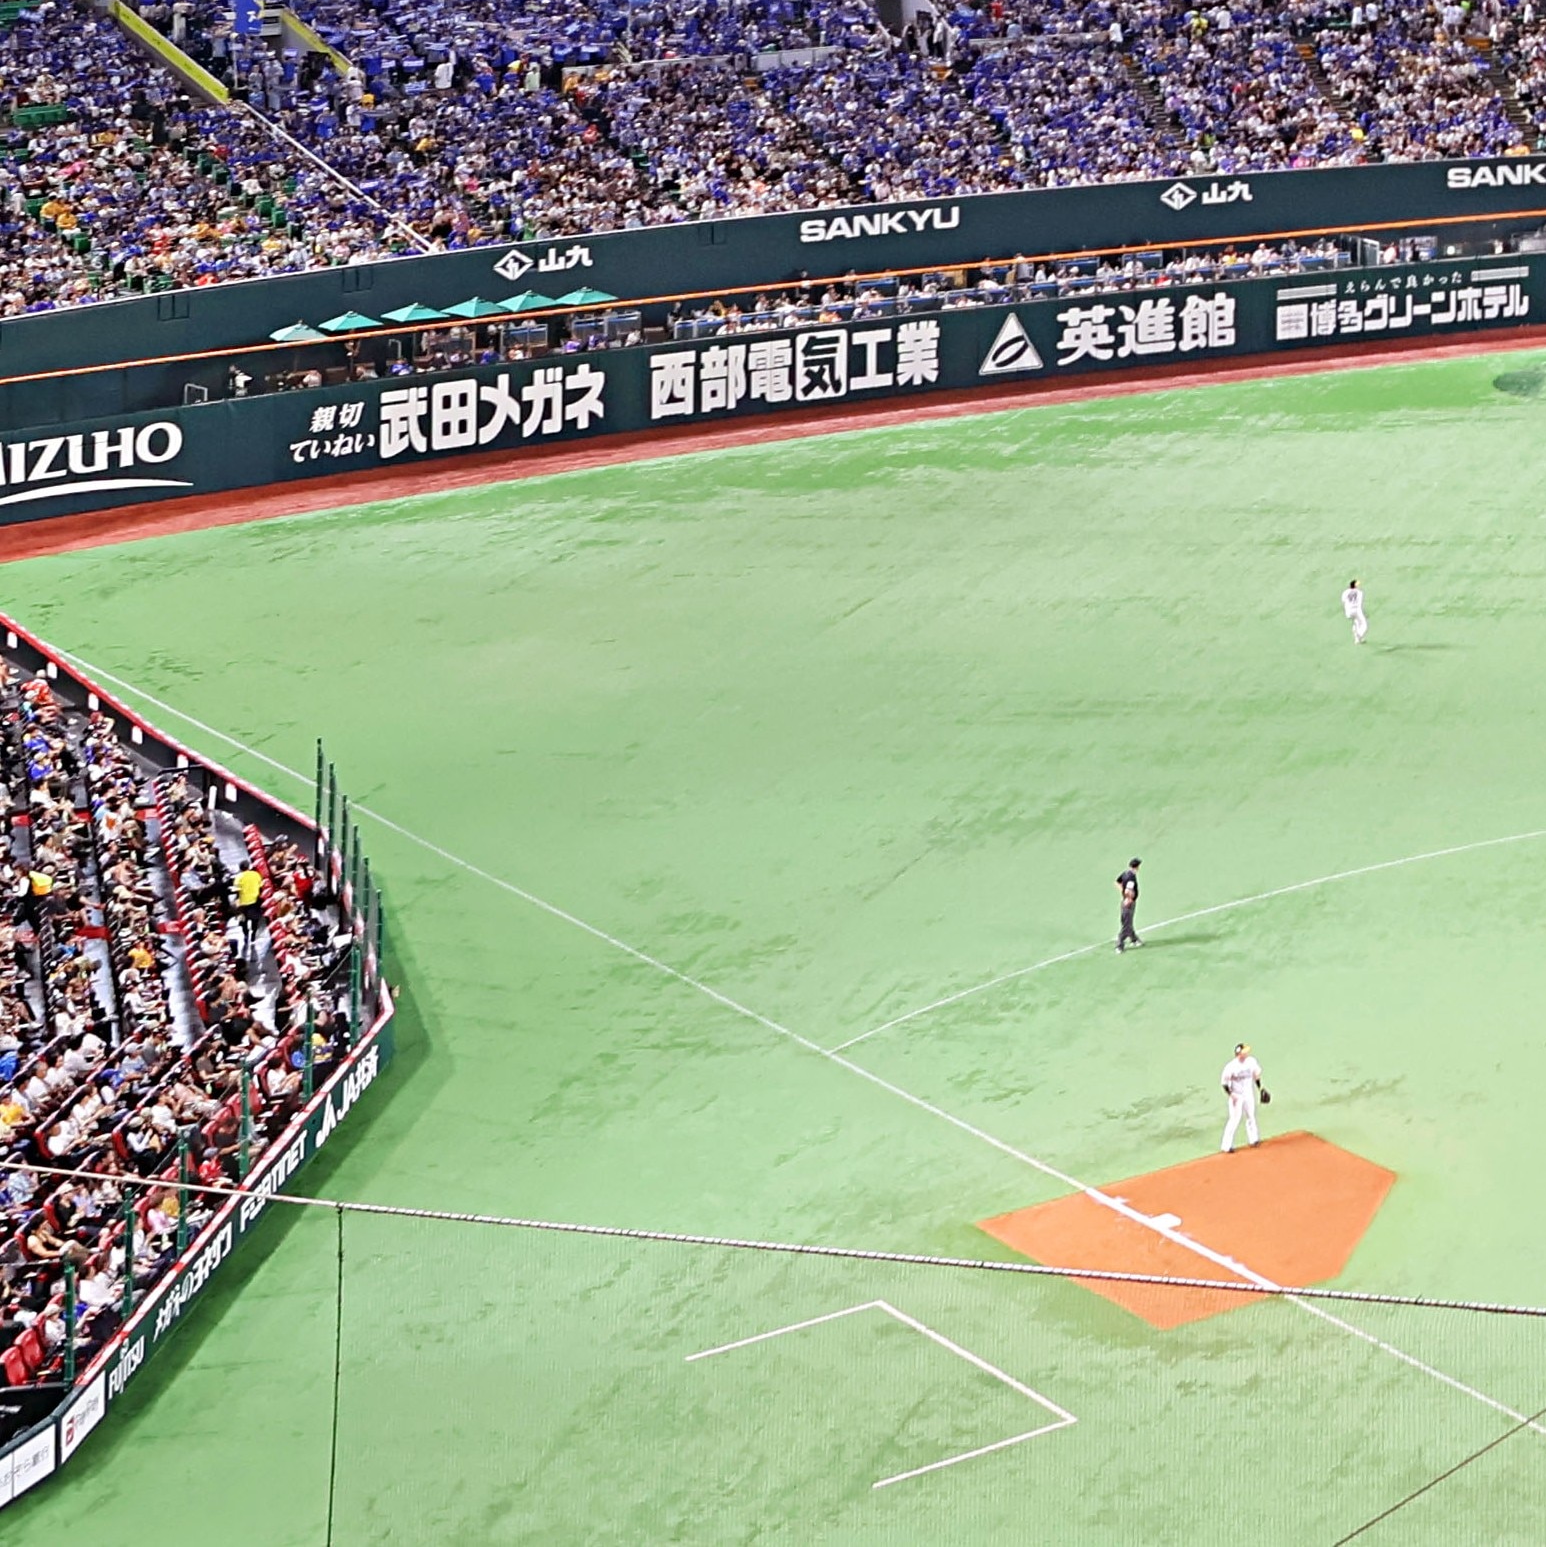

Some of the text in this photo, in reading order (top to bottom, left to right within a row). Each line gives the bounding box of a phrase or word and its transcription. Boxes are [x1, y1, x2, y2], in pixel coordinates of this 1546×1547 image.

[1201, 180, 1253, 205] 山九
[801, 205, 961, 243] SANKYU
[538, 244, 593, 272] 山九
[1056, 291, 1237, 367] 英進館
[1310, 284, 1530, 337] 博多グリーンホテル
[650, 319, 941, 420] 西部電気工業
[309, 401, 365, 433] 親切
[378, 363, 606, 459] 武田メガネ
[289, 434, 376, 463] ていねい
